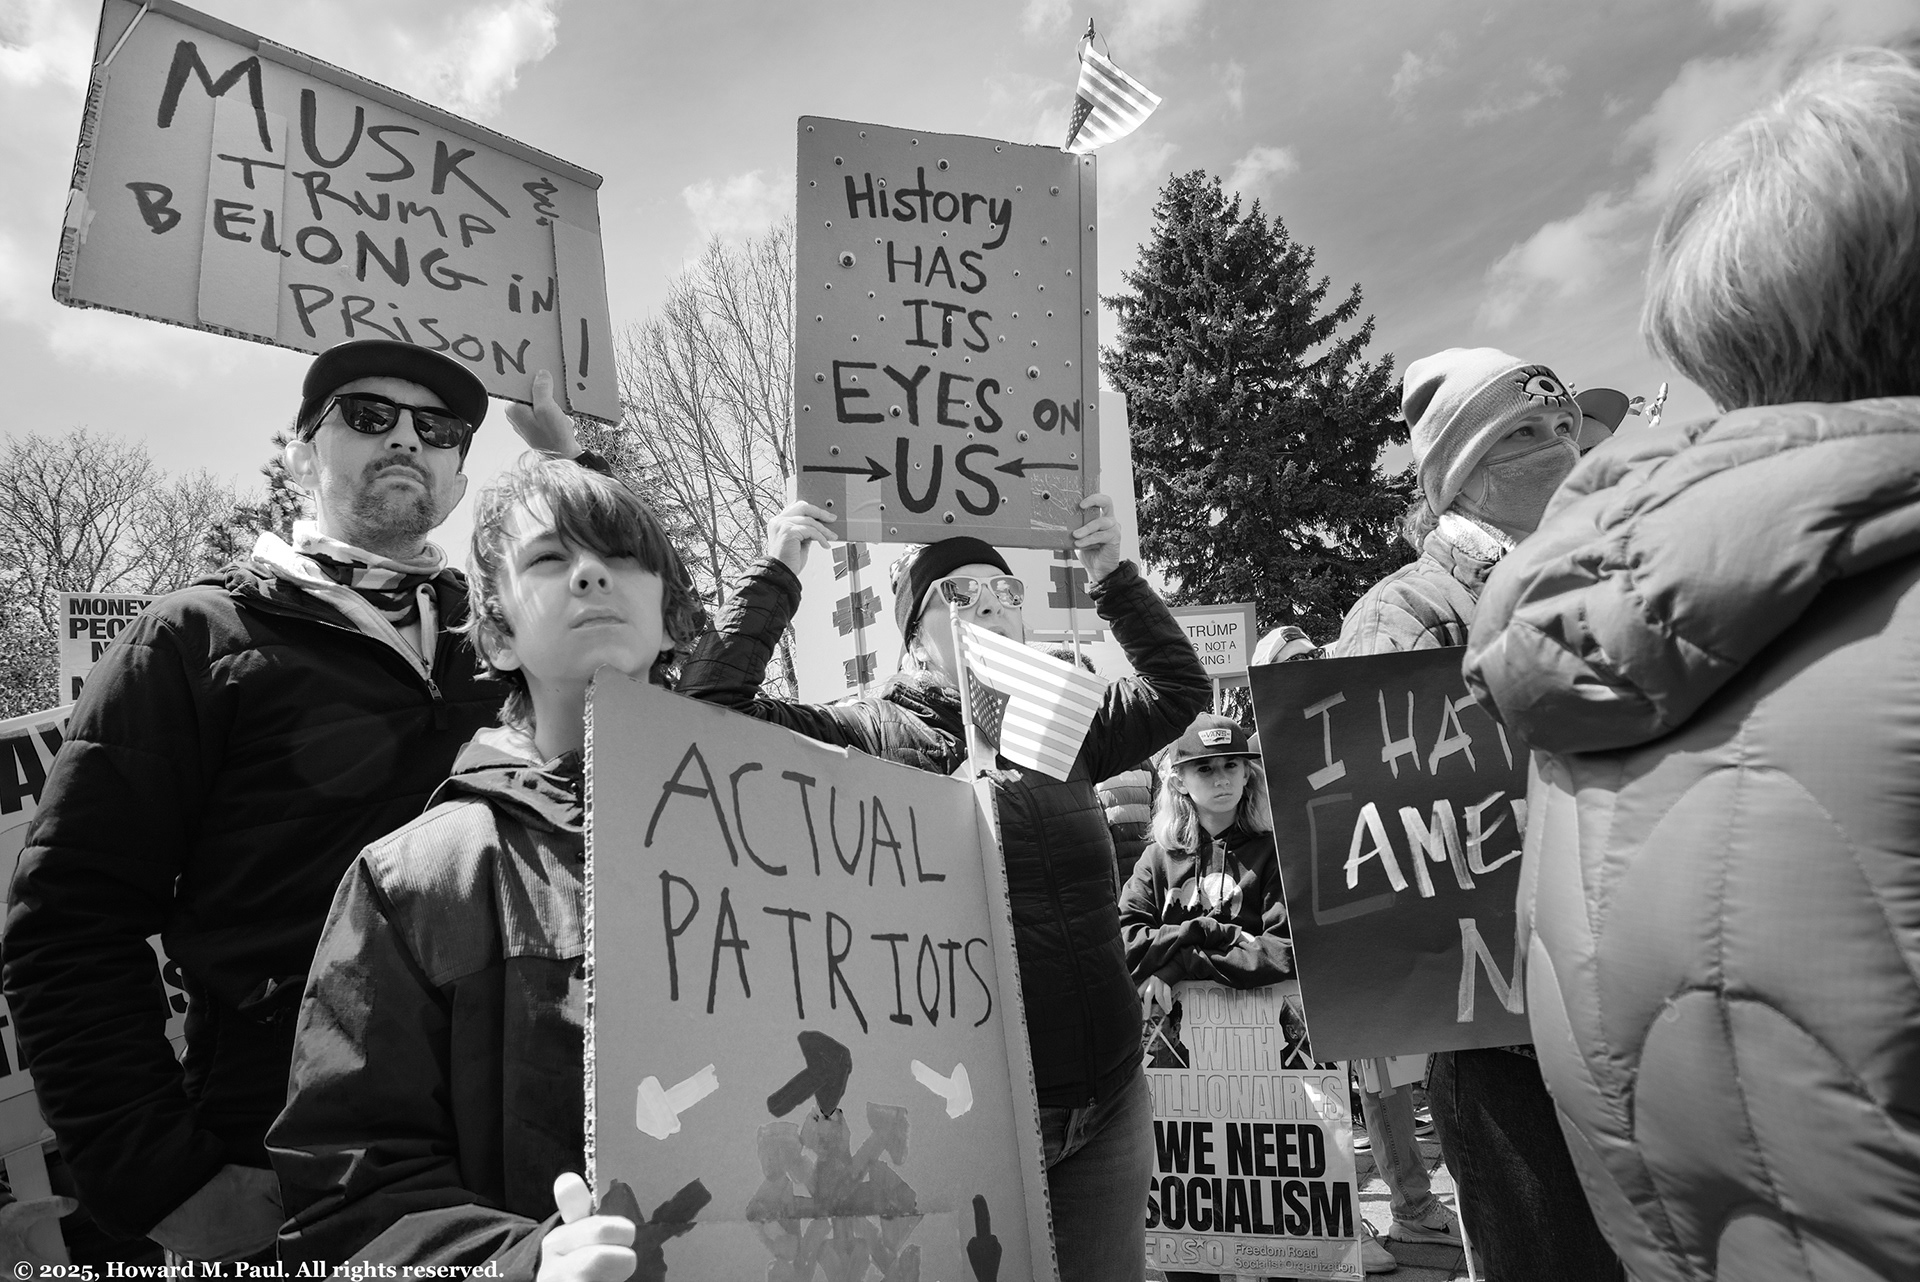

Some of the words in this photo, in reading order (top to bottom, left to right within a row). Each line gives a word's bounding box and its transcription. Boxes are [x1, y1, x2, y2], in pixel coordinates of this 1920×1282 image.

[157, 40, 510, 217] MUSK
[523, 178, 560, 227] &
[217, 153, 496, 248] TRUMP
[844, 166, 1013, 249] History
[126, 181, 487, 291] BELONG
[886, 241, 987, 294] HAS
[903, 299, 992, 353] ITS
[832, 360, 1003, 433] EYES
[1033, 398, 1081, 434] ON
[895, 437, 1001, 515] US
[69, 618, 134, 639] PEO
[1187, 623, 1237, 638] TRUMP
[1192, 642, 1200, 652] S
[1205, 641, 1227, 651] NOT
[1229, 640, 1236, 649] A
[1205, 730, 1227, 738] VANS
[1303, 691, 1347, 791] I
[644, 743, 946, 887] ACTUAL
[660, 870, 993, 1033] PATRIOTS
[1188, 986, 1275, 1026] DOWN
[1190, 1027, 1277, 1071] WITH
[1153, 1120, 1216, 1175] WE
[1225, 1122, 1326, 1178] NEED
[1234, 1243, 1286, 1257] Freedom
[1287, 1245, 1318, 1258] Road
[1234, 1257, 1283, 1269] Socialist
[1285, 1260, 1356, 1273] Organization
